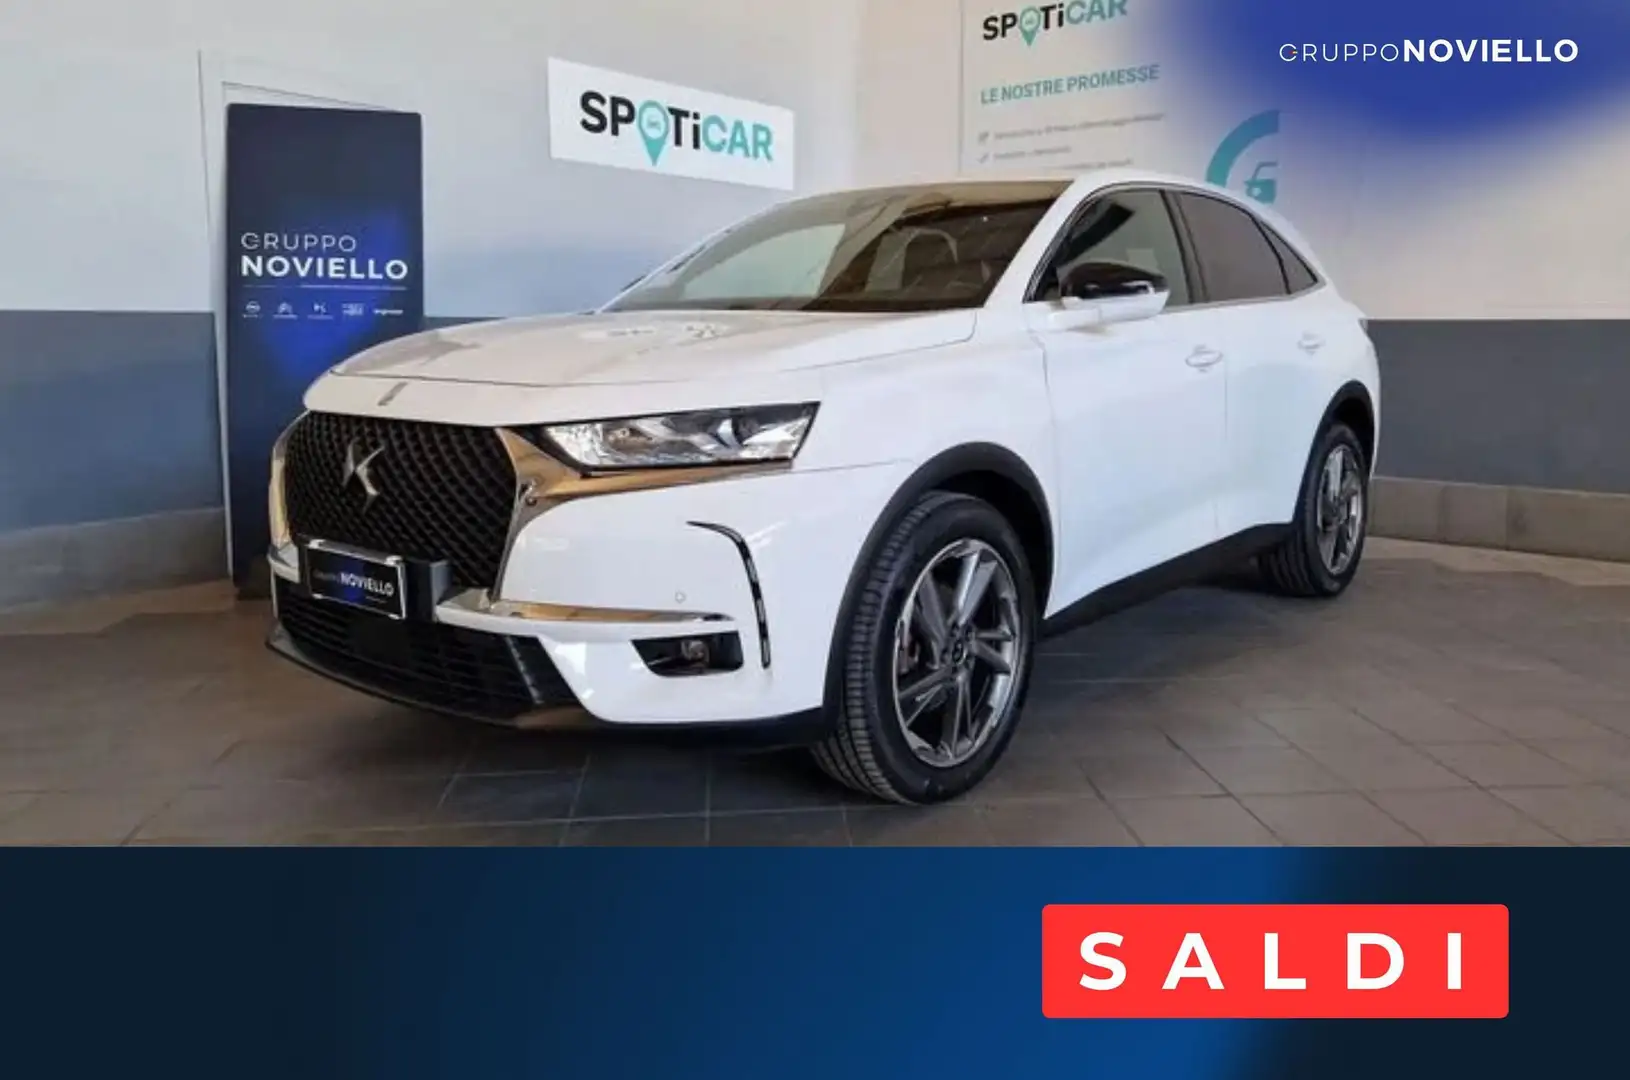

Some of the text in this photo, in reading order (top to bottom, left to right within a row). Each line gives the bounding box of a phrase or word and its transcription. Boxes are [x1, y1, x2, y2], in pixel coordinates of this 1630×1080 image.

[980, 63, 1161, 105] LE NOSTRE PROMESSE
[241, 232, 357, 252] GRUPPO
[241, 255, 408, 280] NOVIELLO
